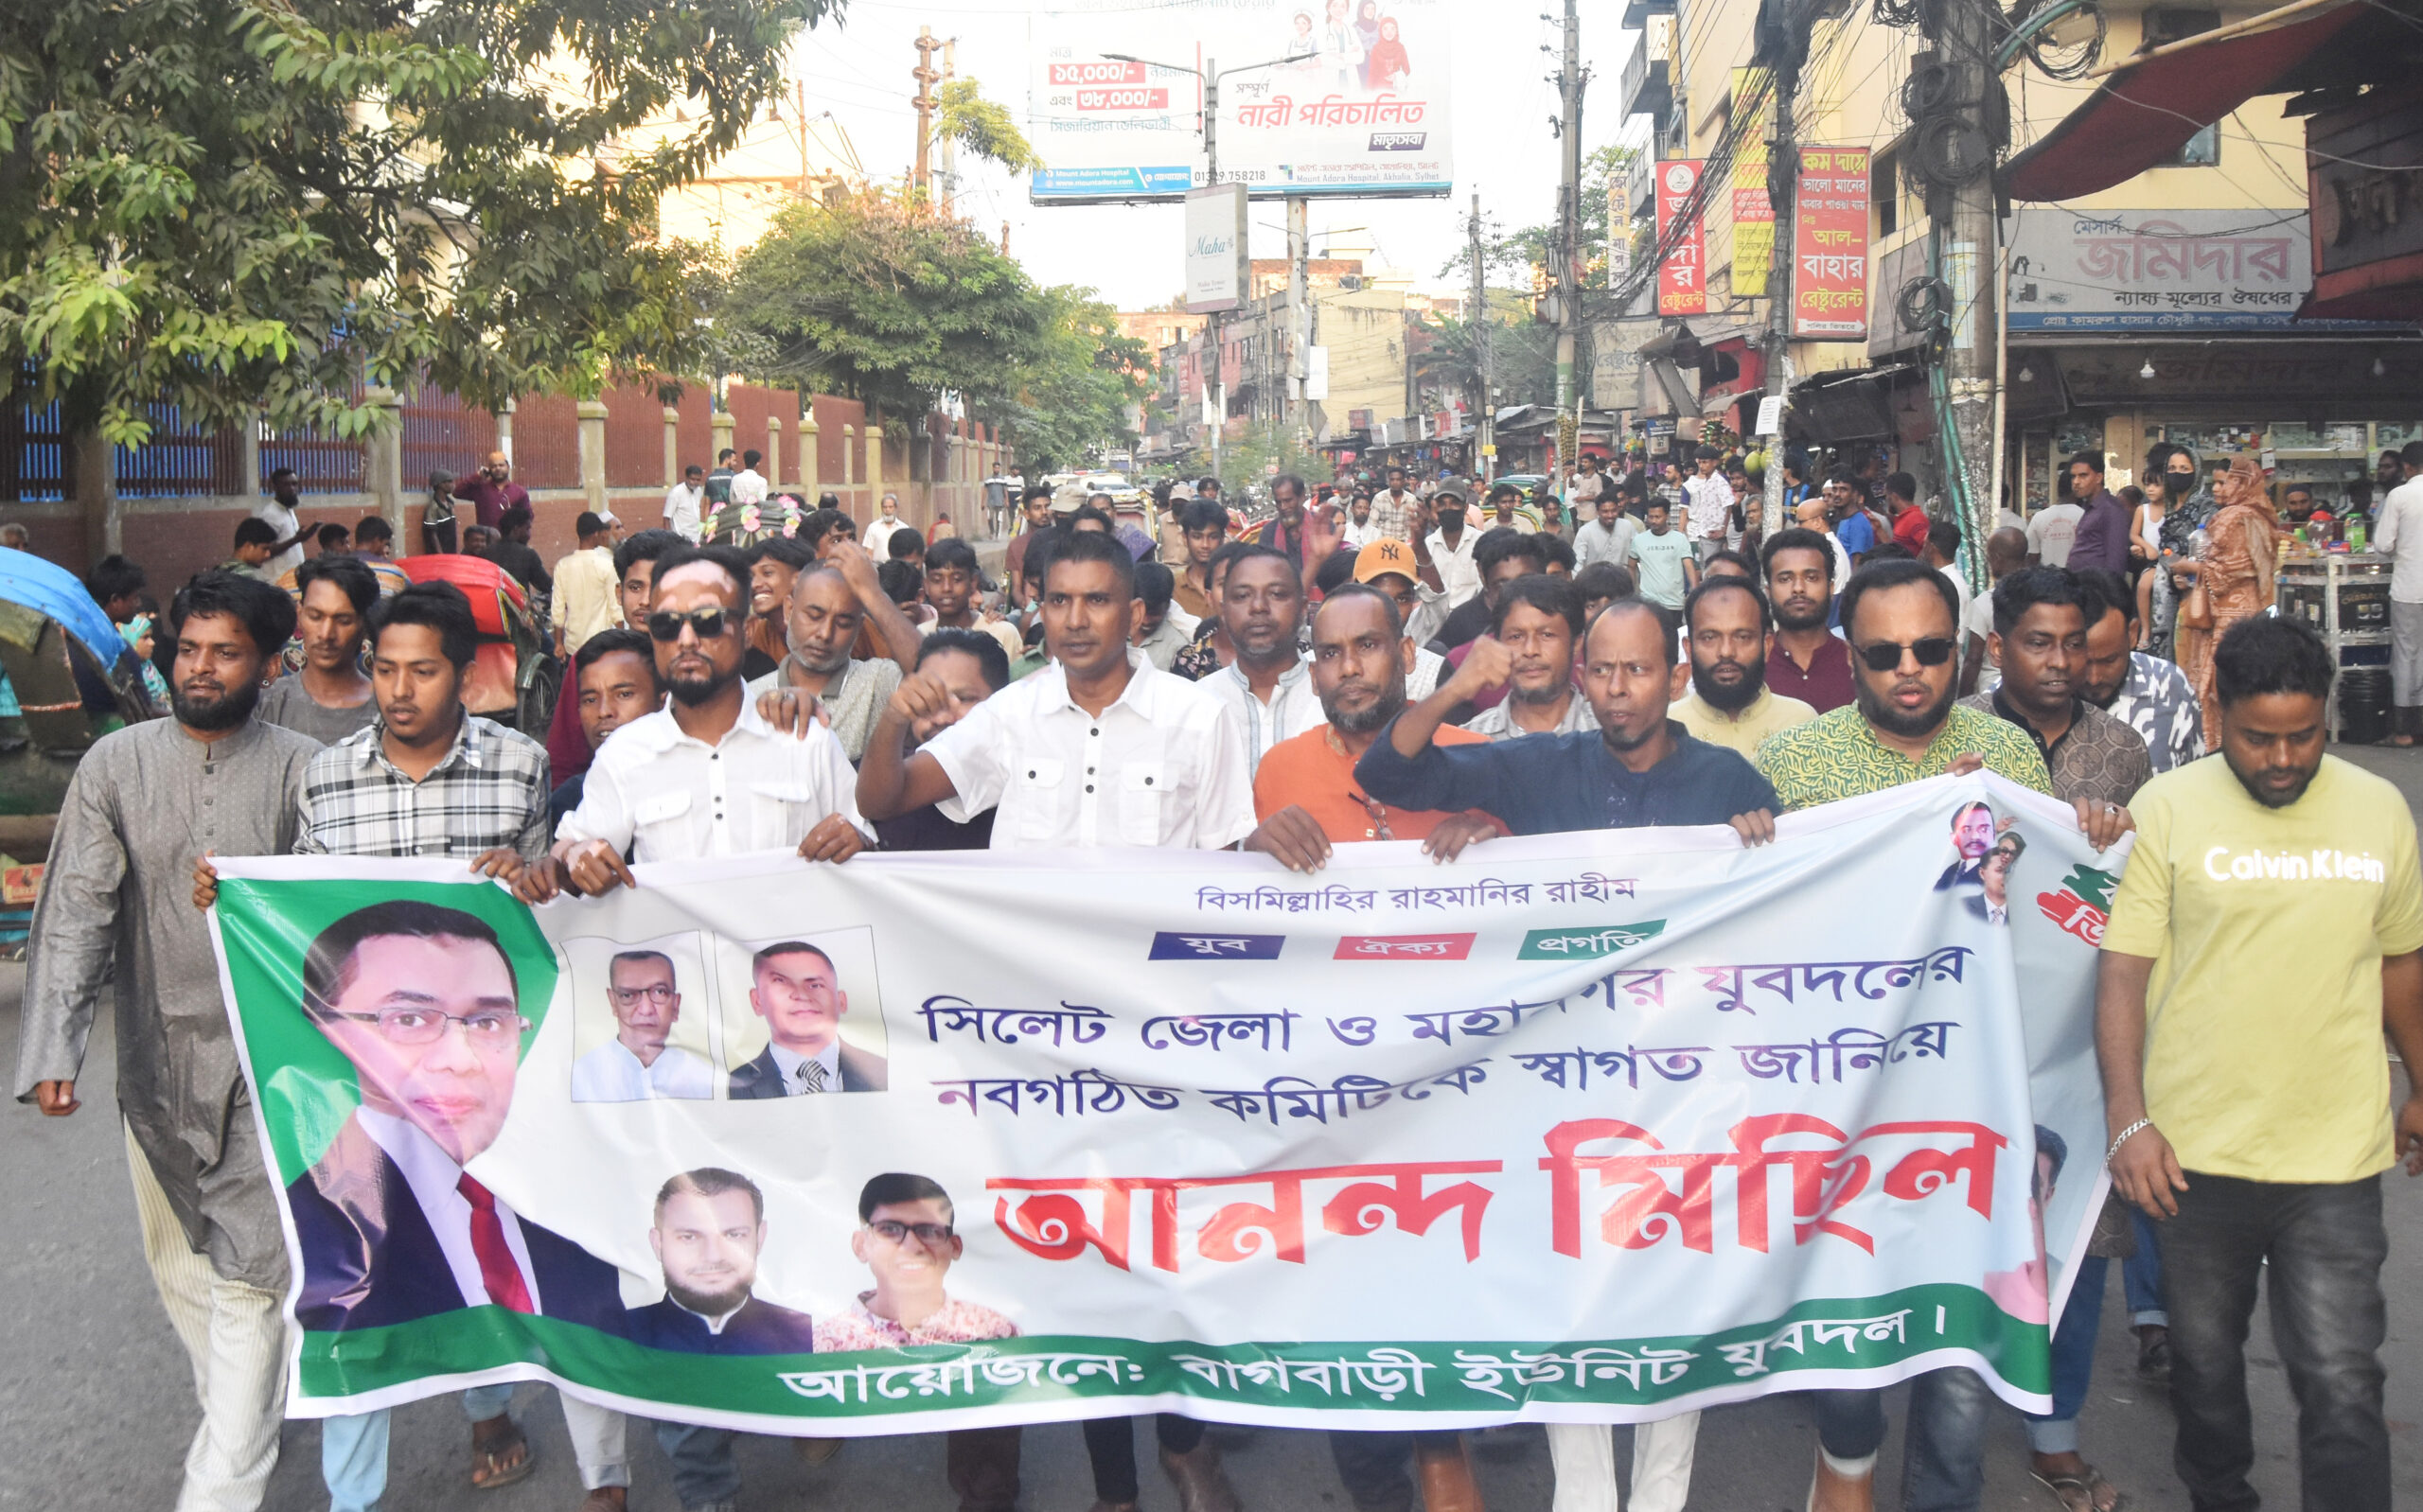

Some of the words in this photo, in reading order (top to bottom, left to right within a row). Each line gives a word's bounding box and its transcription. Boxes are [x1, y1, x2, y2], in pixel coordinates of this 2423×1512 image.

[1049, 96, 1073, 107] এবং
[1237, 95, 1295, 129] নারী
[1299, 93, 1427, 128] পরিচালিত
[1101, 168, 1130, 177] Hospital
[1802, 152, 1831, 171] কম
[1194, 170, 1226, 182] 0139
[1228, 170, 1266, 182] 758218
[1297, 174, 1320, 183] Mount
[1322, 173, 1346, 183] Adora
[1415, 170, 1440, 182] Sylhet
[1801, 177, 1832, 193] ভালো
[1834, 179, 1866, 194] মানের
[2074, 214, 2124, 236] মেসার্স
[1189, 235, 1226, 257] Maha
[2073, 219, 2292, 284] জমিদার
[1801, 252, 1866, 282] বাহার
[2203, 846, 2309, 882] Calvin
[2312, 849, 2384, 884] Klein
[1195, 885, 1379, 913] বিসমিল্লাহির
[1388, 876, 1536, 910] রাহমানির
[1543, 872, 1641, 905] রাহীম
[1179, 934, 1253, 956] যুব
[1537, 930, 1650, 954] প্রগতি
[916, 994, 1115, 1049] সিলেট
[1140, 1007, 1302, 1054] জেলা
[1326, 1014, 1378, 1047] ও
[1690, 944, 1976, 1016] যুবদলের
[930, 1066, 1185, 1118] নবগঠিত
[1196, 1057, 1494, 1126] কমিটিকে
[1511, 1043, 1715, 1092] স্বাগত
[1730, 1020, 1963, 1086] জানিয়ে
[984, 1159, 1504, 1275] আনন্দ
[1537, 1112, 2008, 1261] মিছিল
[1170, 1347, 1439, 1404] বাগবাড়ী
[1451, 1344, 1701, 1403] ইউনিট
[1717, 1308, 1915, 1379] যুবদল
